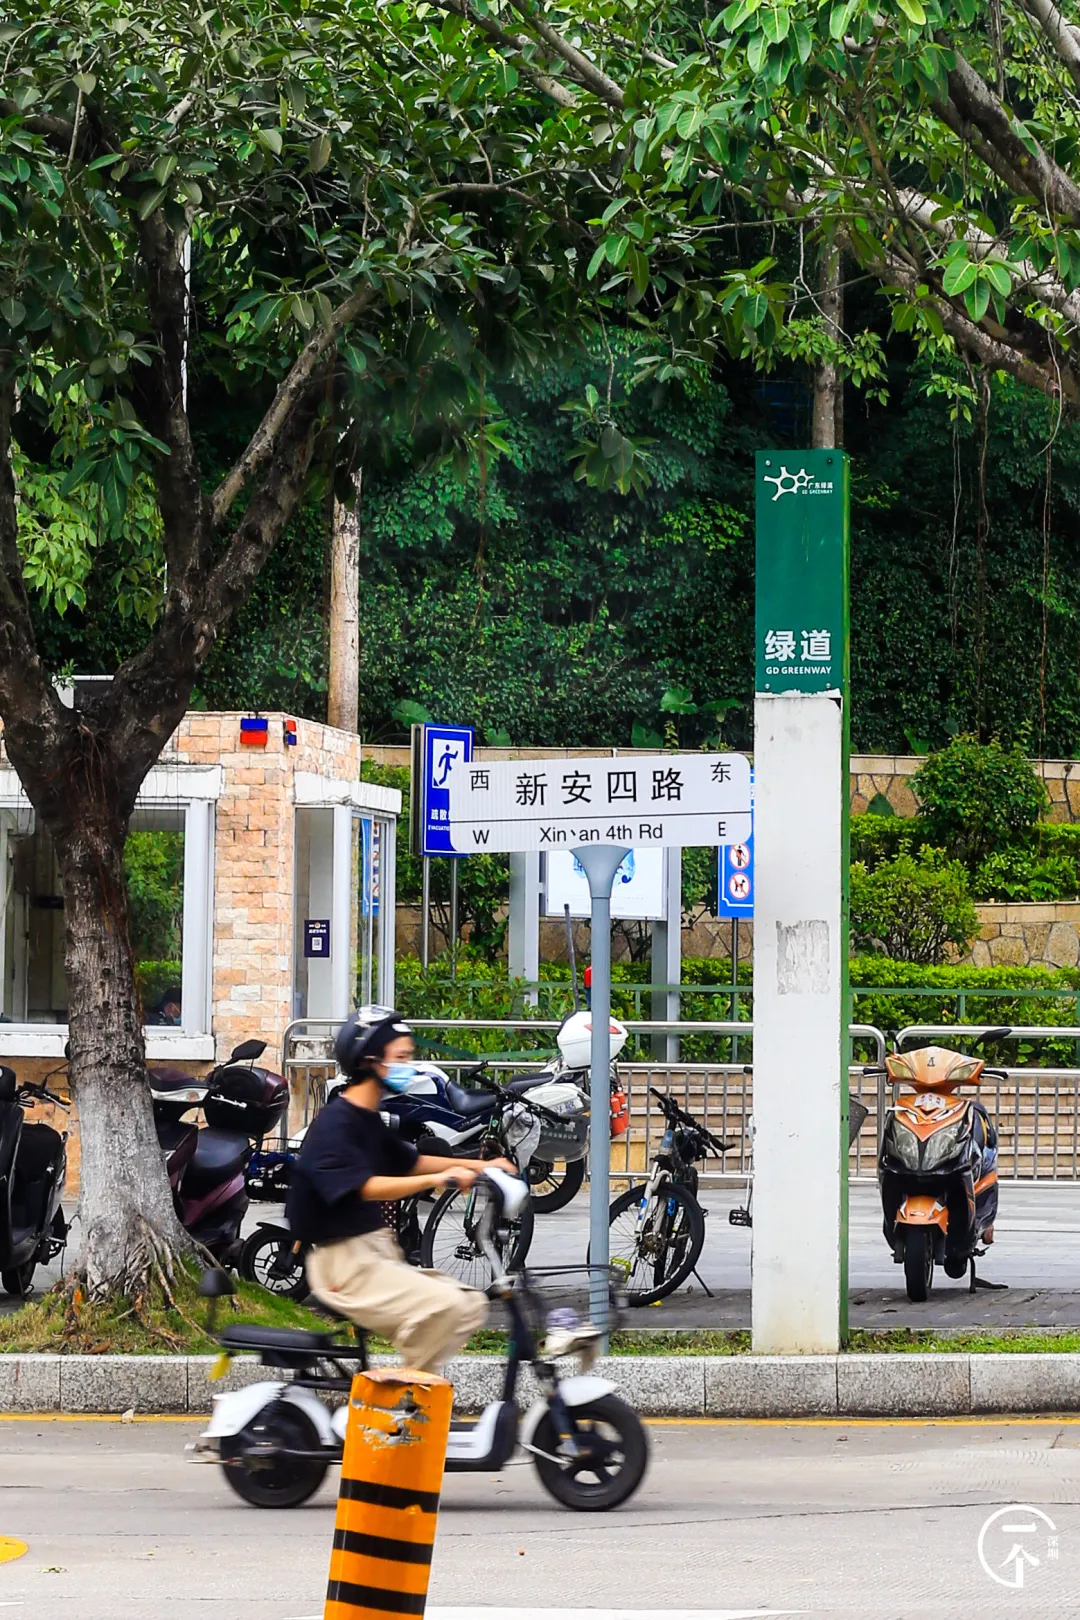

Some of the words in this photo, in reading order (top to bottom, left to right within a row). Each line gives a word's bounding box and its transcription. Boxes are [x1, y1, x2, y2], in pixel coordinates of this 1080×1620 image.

[764, 629, 832, 662] 绿道
[765, 666, 780, 675] GD
[781, 666, 832, 675] GREENWAY
[470, 769, 490, 791] 西
[710, 761, 732, 783] 东
[515, 767, 684, 806] 新安四路
[472, 829, 489, 845] W
[605, 824, 633, 840] 4th
[639, 822, 664, 840] Rd
[718, 821, 727, 837] E
